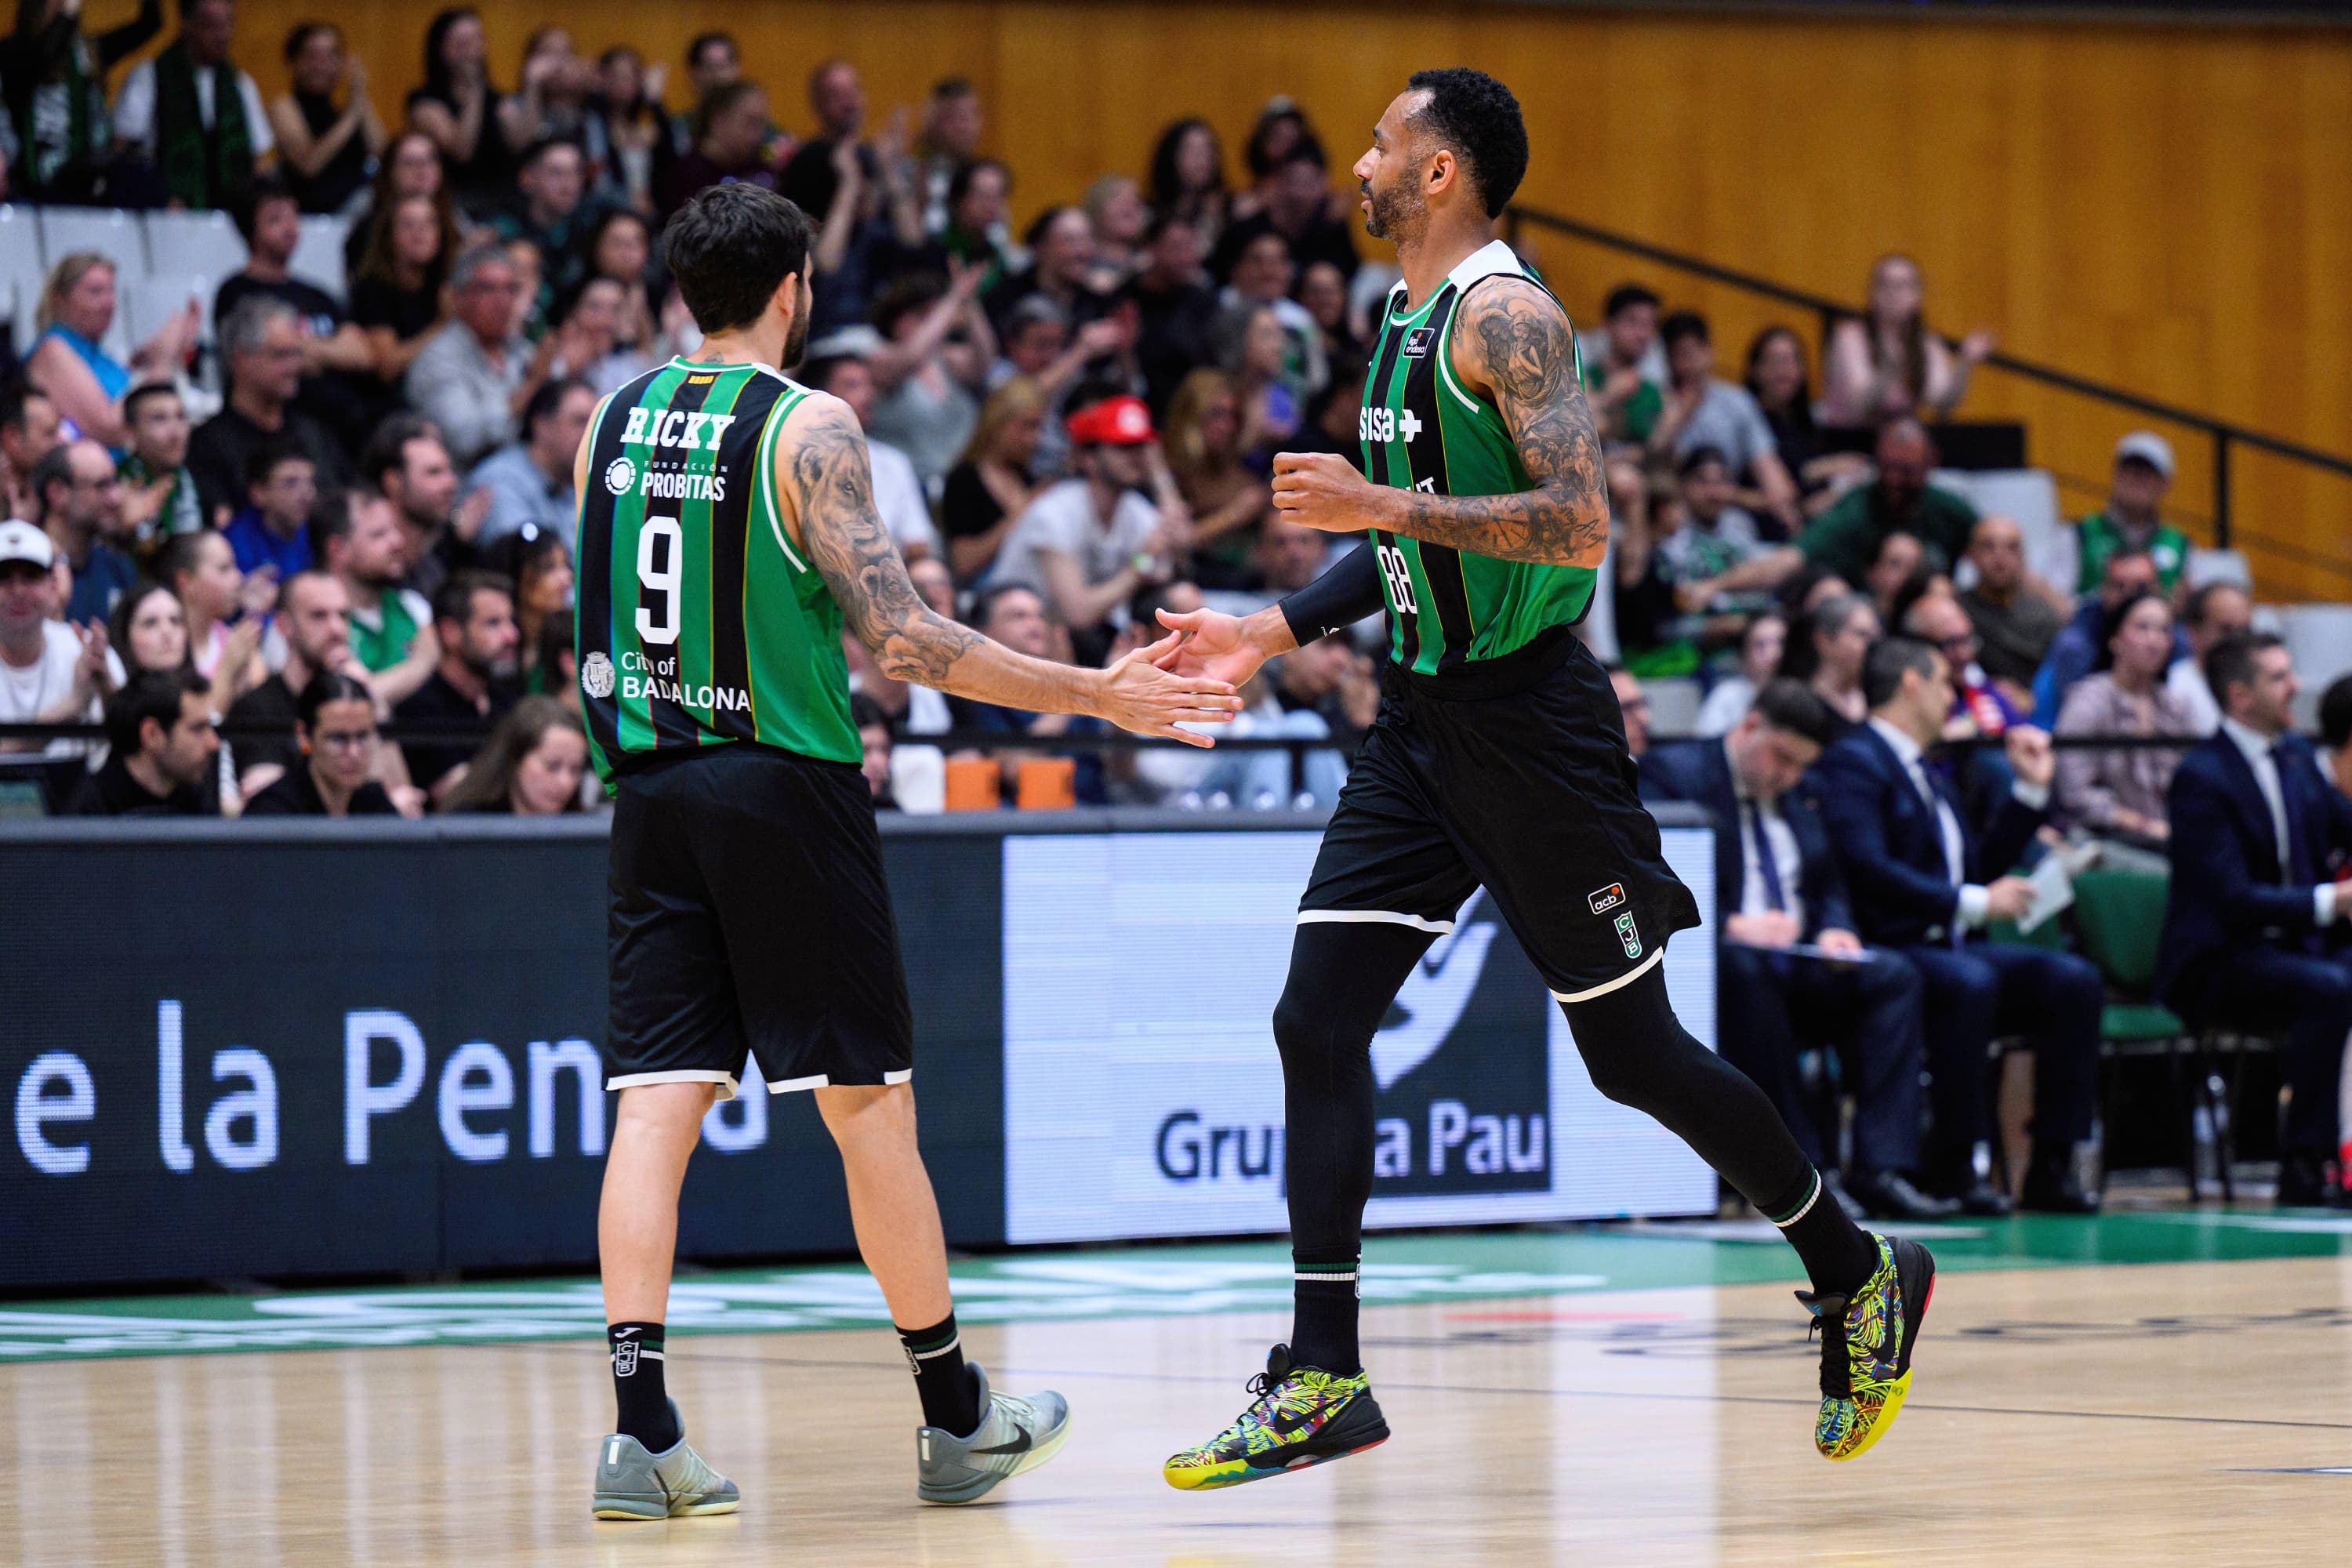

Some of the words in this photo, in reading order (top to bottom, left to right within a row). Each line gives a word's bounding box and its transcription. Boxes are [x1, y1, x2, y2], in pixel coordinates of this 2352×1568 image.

[620, 407, 736, 450] RICKY
[640, 472, 726, 501] PROBITAS
[635, 516, 682, 644] 9
[1377, 546, 1417, 614] 88
[622, 652, 654, 675] City
[658, 657, 676, 676] of
[622, 677, 752, 712] BADALONA
[1595, 895, 1617, 909] acb
[158, 1000, 279, 1172] la
[345, 1010, 768, 1163] Pena
[1156, 1109, 1286, 1197] Gru
[1428, 1099, 1545, 1176] Pau
